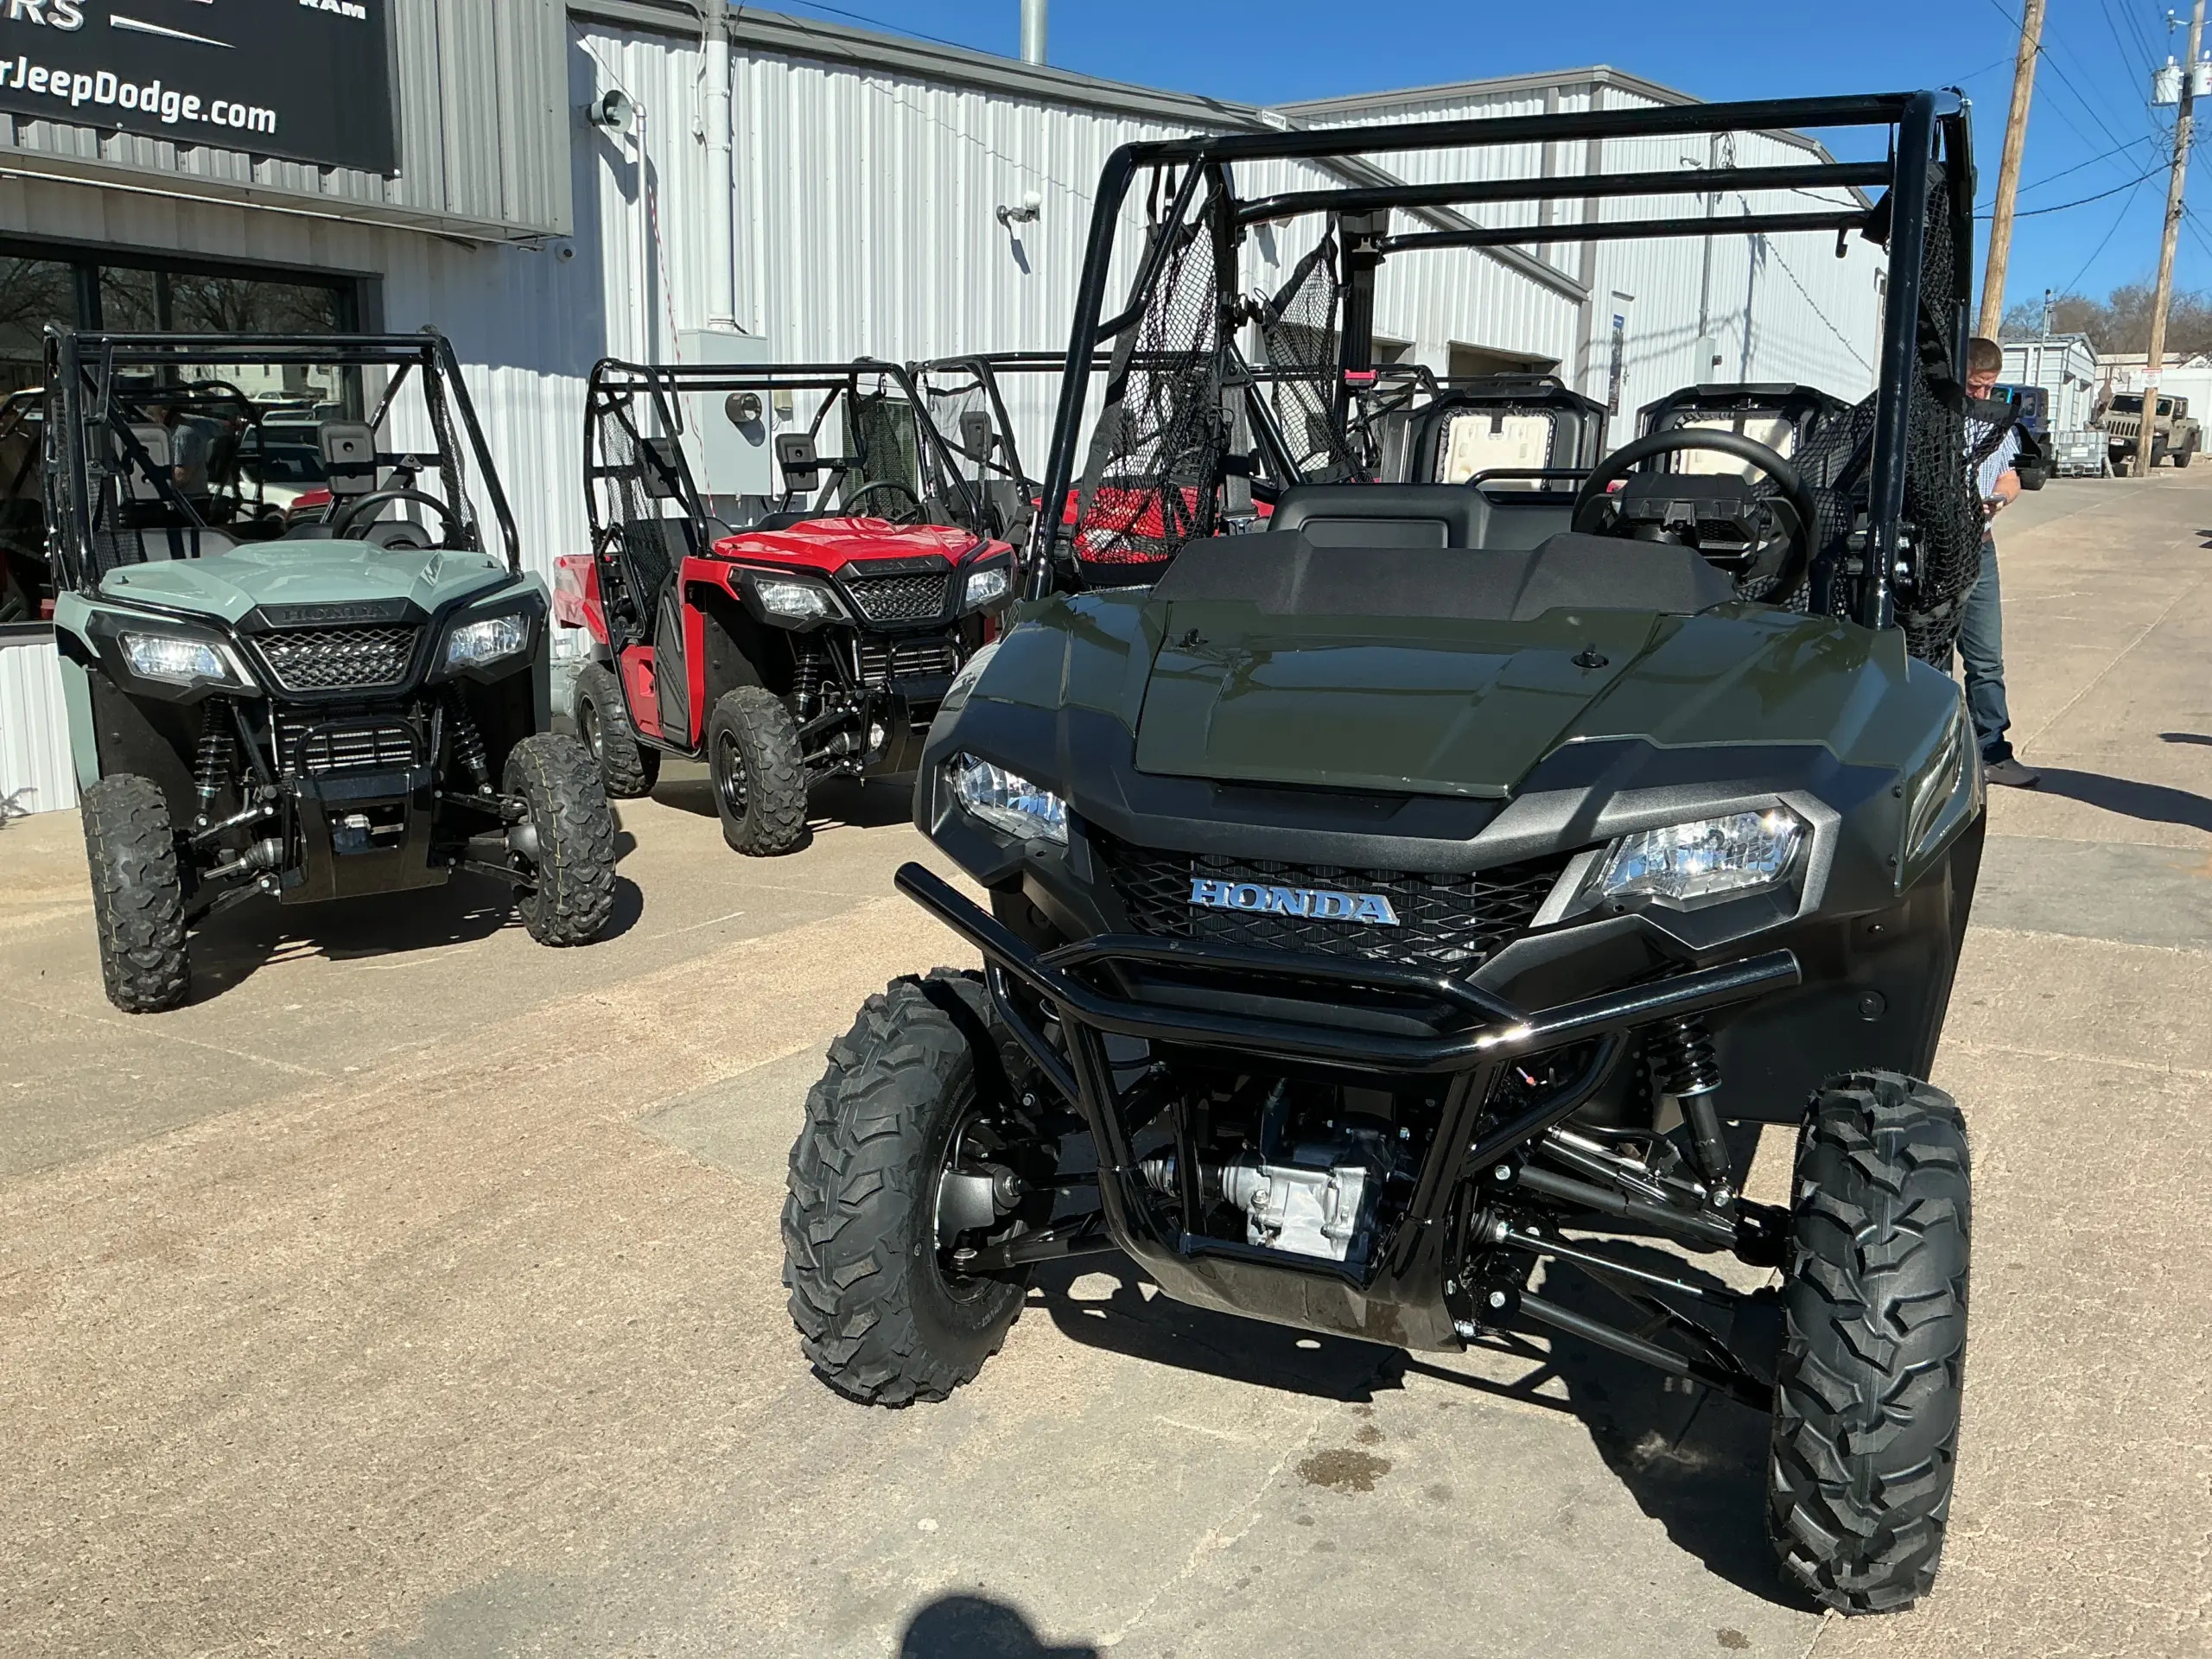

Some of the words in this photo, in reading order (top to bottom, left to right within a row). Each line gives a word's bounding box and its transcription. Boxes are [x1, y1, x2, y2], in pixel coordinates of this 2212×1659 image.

[0, 55, 276, 133] rJeepDodge.com
[283, 605, 391, 621] HONDA
[1187, 878, 1400, 926] HONDA
